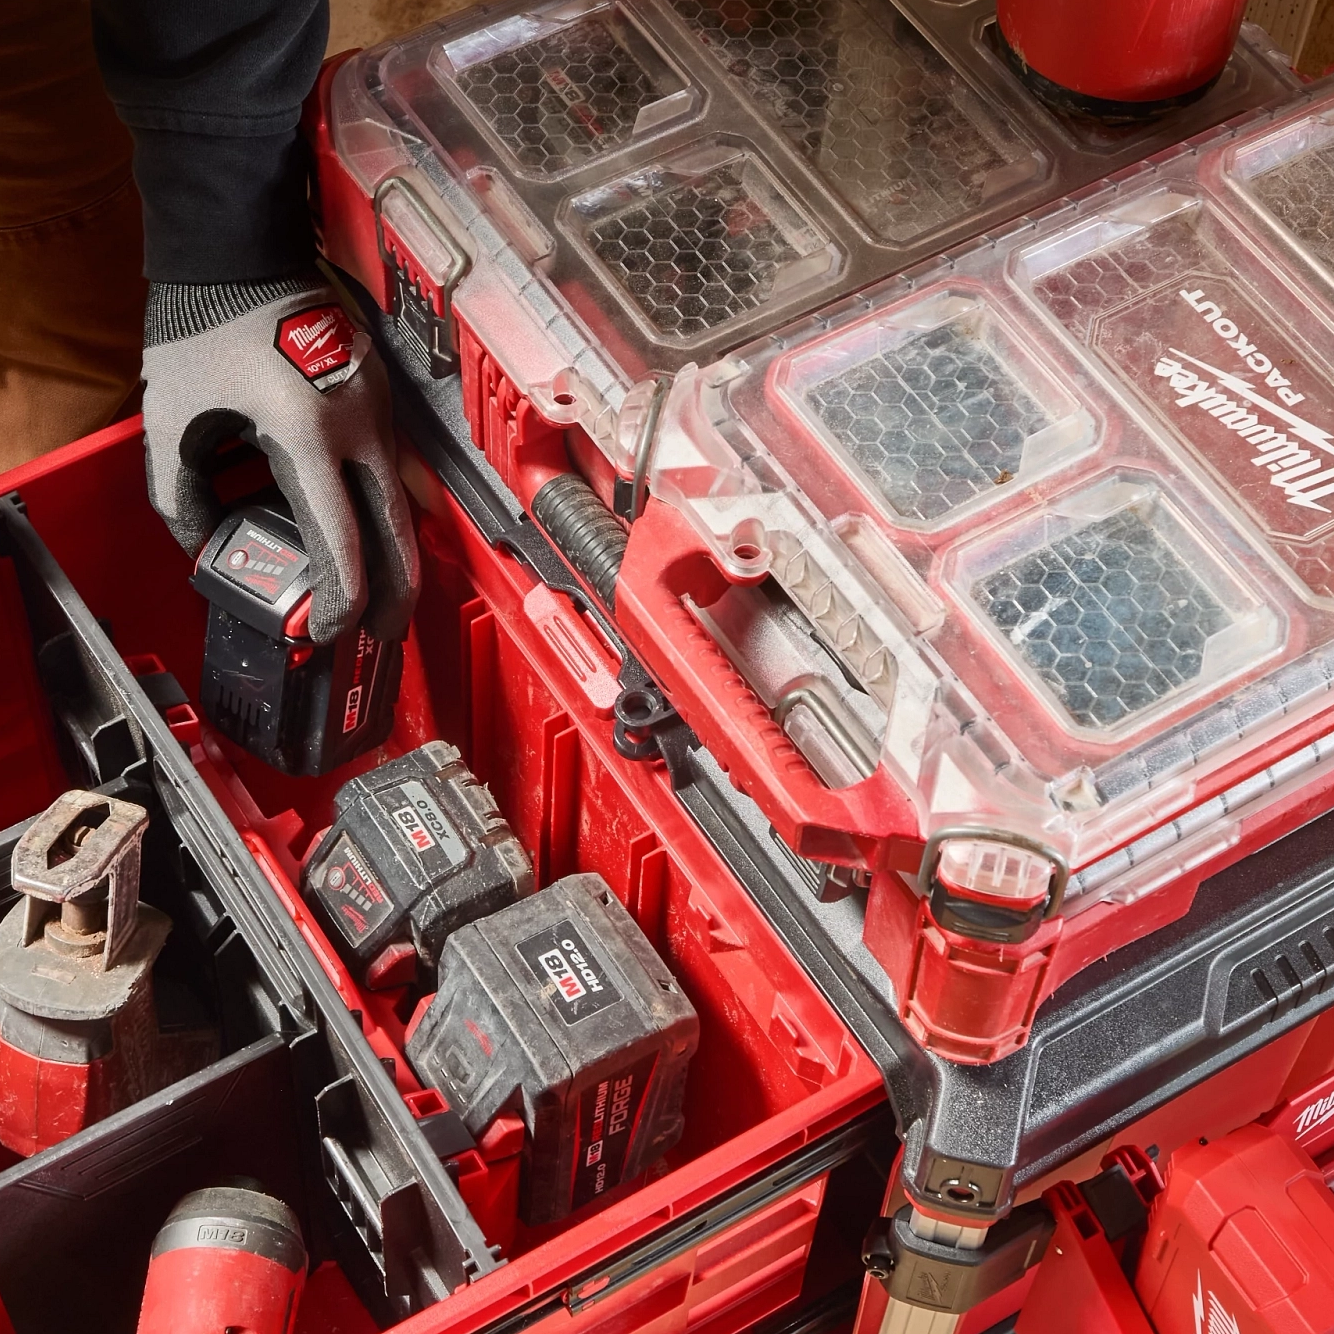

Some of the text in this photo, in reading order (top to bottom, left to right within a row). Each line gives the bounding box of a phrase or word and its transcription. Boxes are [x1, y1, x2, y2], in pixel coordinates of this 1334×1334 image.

[287, 312, 335, 350] Milwaukee
[1179, 289, 1305, 407] PACKOUT
[324, 356, 338, 367] XL
[327, 371, 345, 383] CUT
[345, 689, 360, 731] M18
[397, 810, 432, 849] M18
[417, 799, 450, 841] XC8.0
[343, 846, 384, 904] REDLITHIUM
[544, 954, 582, 998] M18
[561, 939, 604, 992] HD12.0
[608, 1074, 633, 1136] FORGE
[200, 1227, 246, 1244] M18
